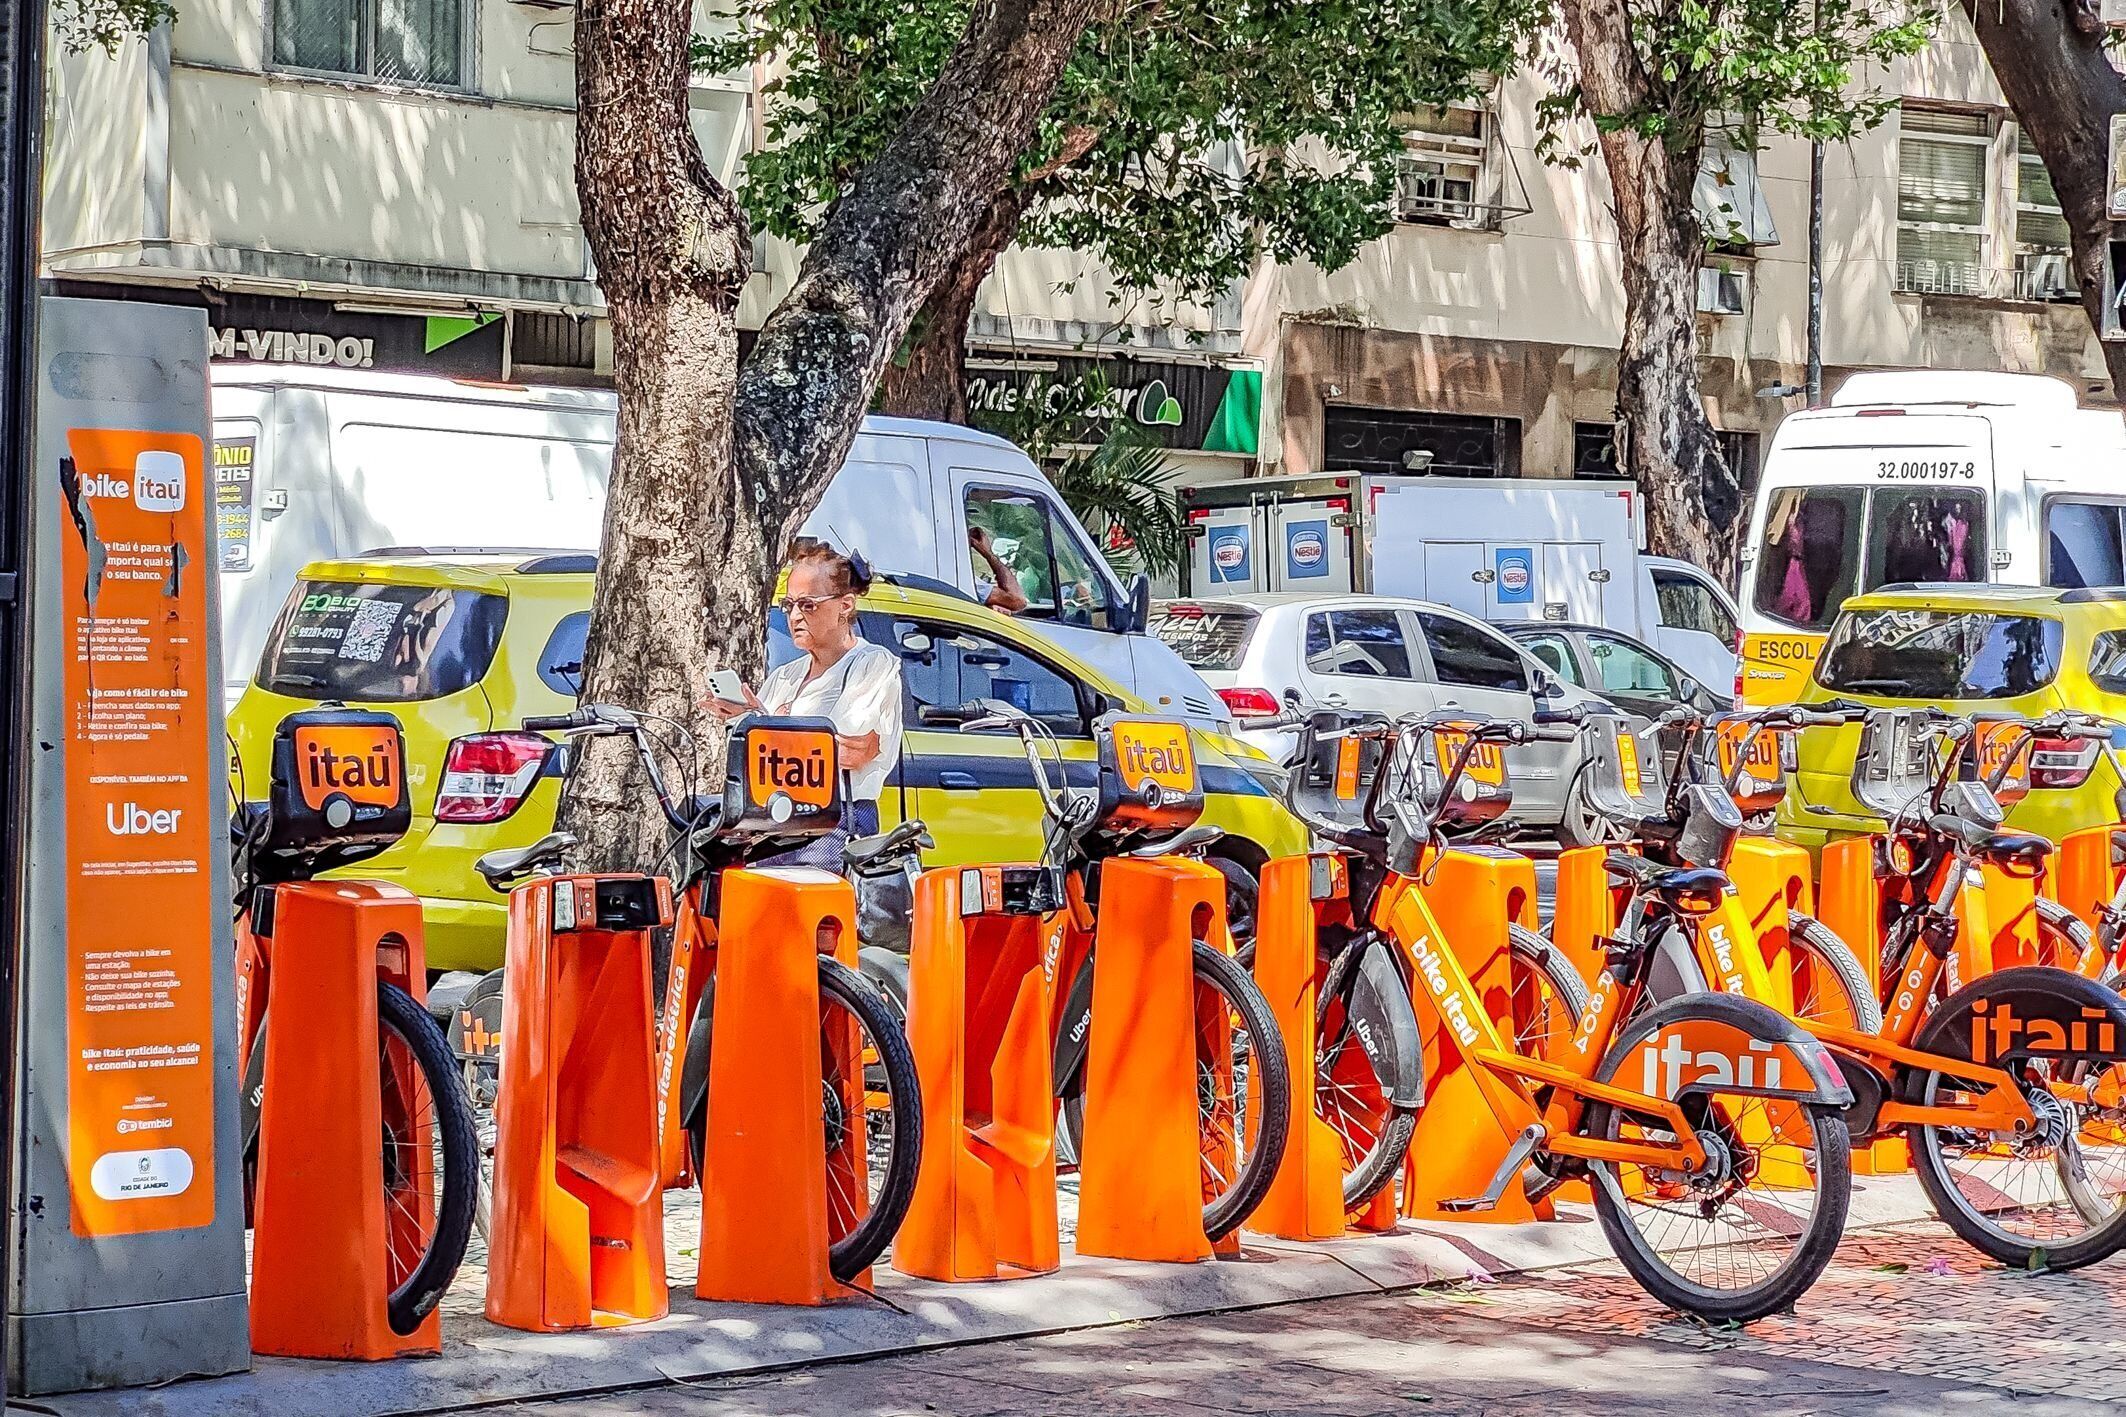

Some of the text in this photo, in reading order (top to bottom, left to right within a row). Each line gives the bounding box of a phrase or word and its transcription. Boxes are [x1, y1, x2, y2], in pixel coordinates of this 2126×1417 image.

[1877, 462, 1975, 479] 32.000197-8
[82, 473, 180, 499] bike itaú
[112, 541, 131, 553] Itaú
[133, 541, 139, 552] é
[141, 544, 161, 555] para
[115, 571, 131, 580] seu
[132, 567, 162, 581] banco.
[144, 557, 162, 571] qual
[1158, 633, 1209, 641] SEGUROS
[126, 689, 132, 697] é
[133, 688, 150, 697] fácil
[159, 689, 170, 697] de
[308, 742, 391, 787] itaú
[758, 743, 825, 788] itaú
[1123, 735, 1186, 774] itaú
[106, 802, 182, 835] Uber
[1707, 923, 1734, 974] bike
[1410, 934, 1480, 1048] bike itaú
[1069, 1008, 1092, 1043] Uber
[1574, 969, 1614, 1055] R804
[1356, 1017, 1379, 1056] Uber
[1971, 998, 2115, 1064] itaú
[82, 1049, 102, 1058] bike
[125, 1045, 175, 1057] praticidade,
[176, 1042, 201, 1053] saúde
[87, 1056, 199, 1071] e economia ao seu alcance!
[1643, 1029, 1781, 1101] itaú
[138, 1117, 173, 1130] tembici
[142, 1182, 169, 1190] JANEIRO
